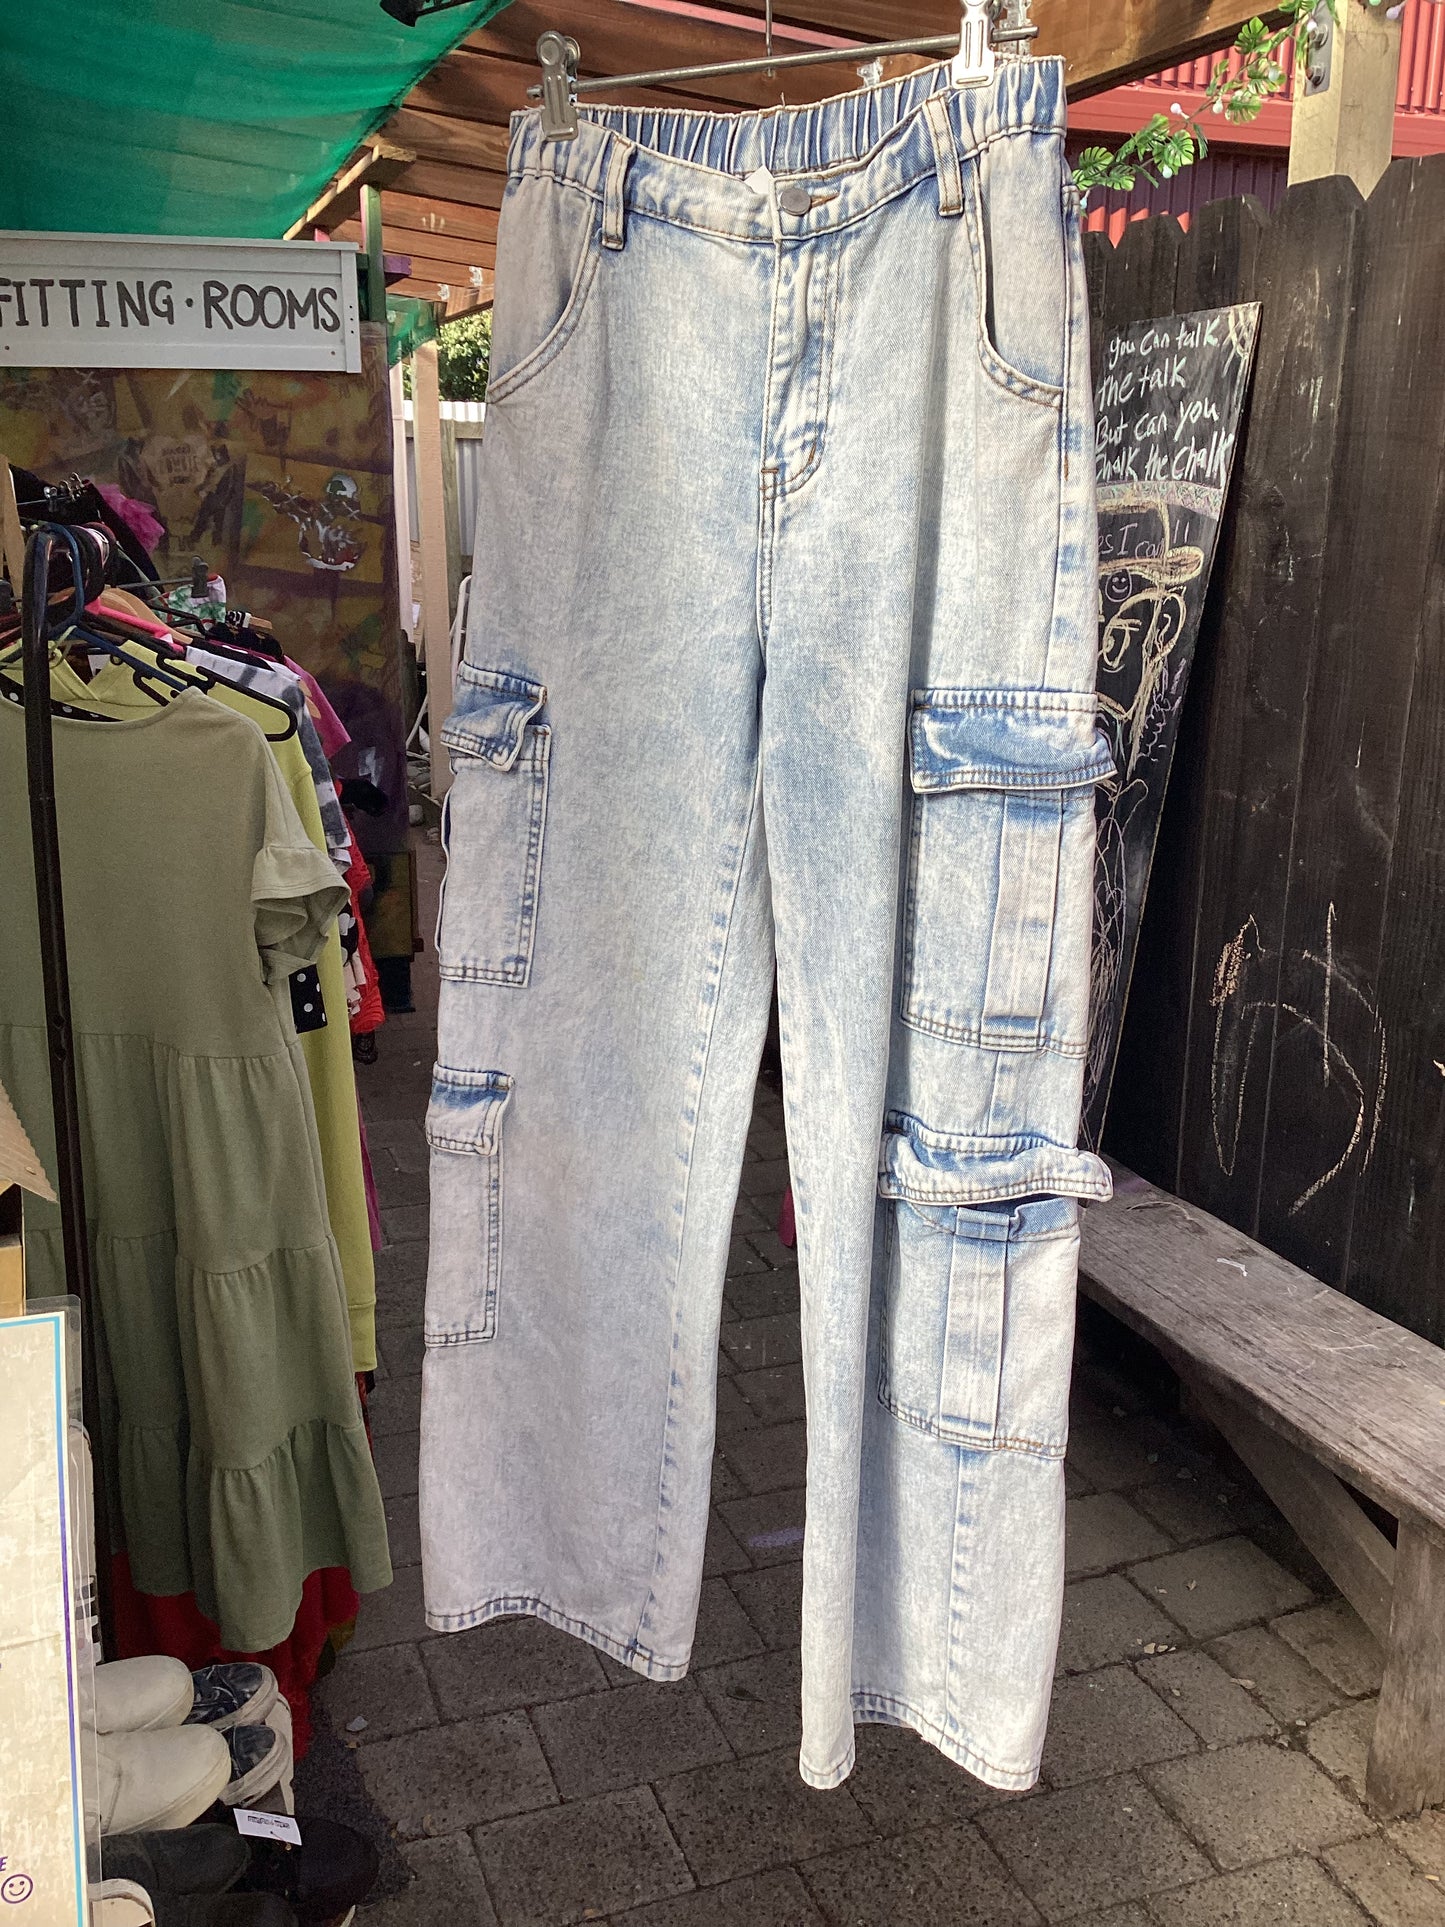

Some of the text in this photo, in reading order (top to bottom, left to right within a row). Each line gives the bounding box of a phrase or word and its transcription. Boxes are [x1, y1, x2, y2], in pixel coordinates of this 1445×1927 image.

[203, 280, 341, 332] ROOMS
[1096, 410, 1128, 451] But
[1173, 397, 1220, 442] you
